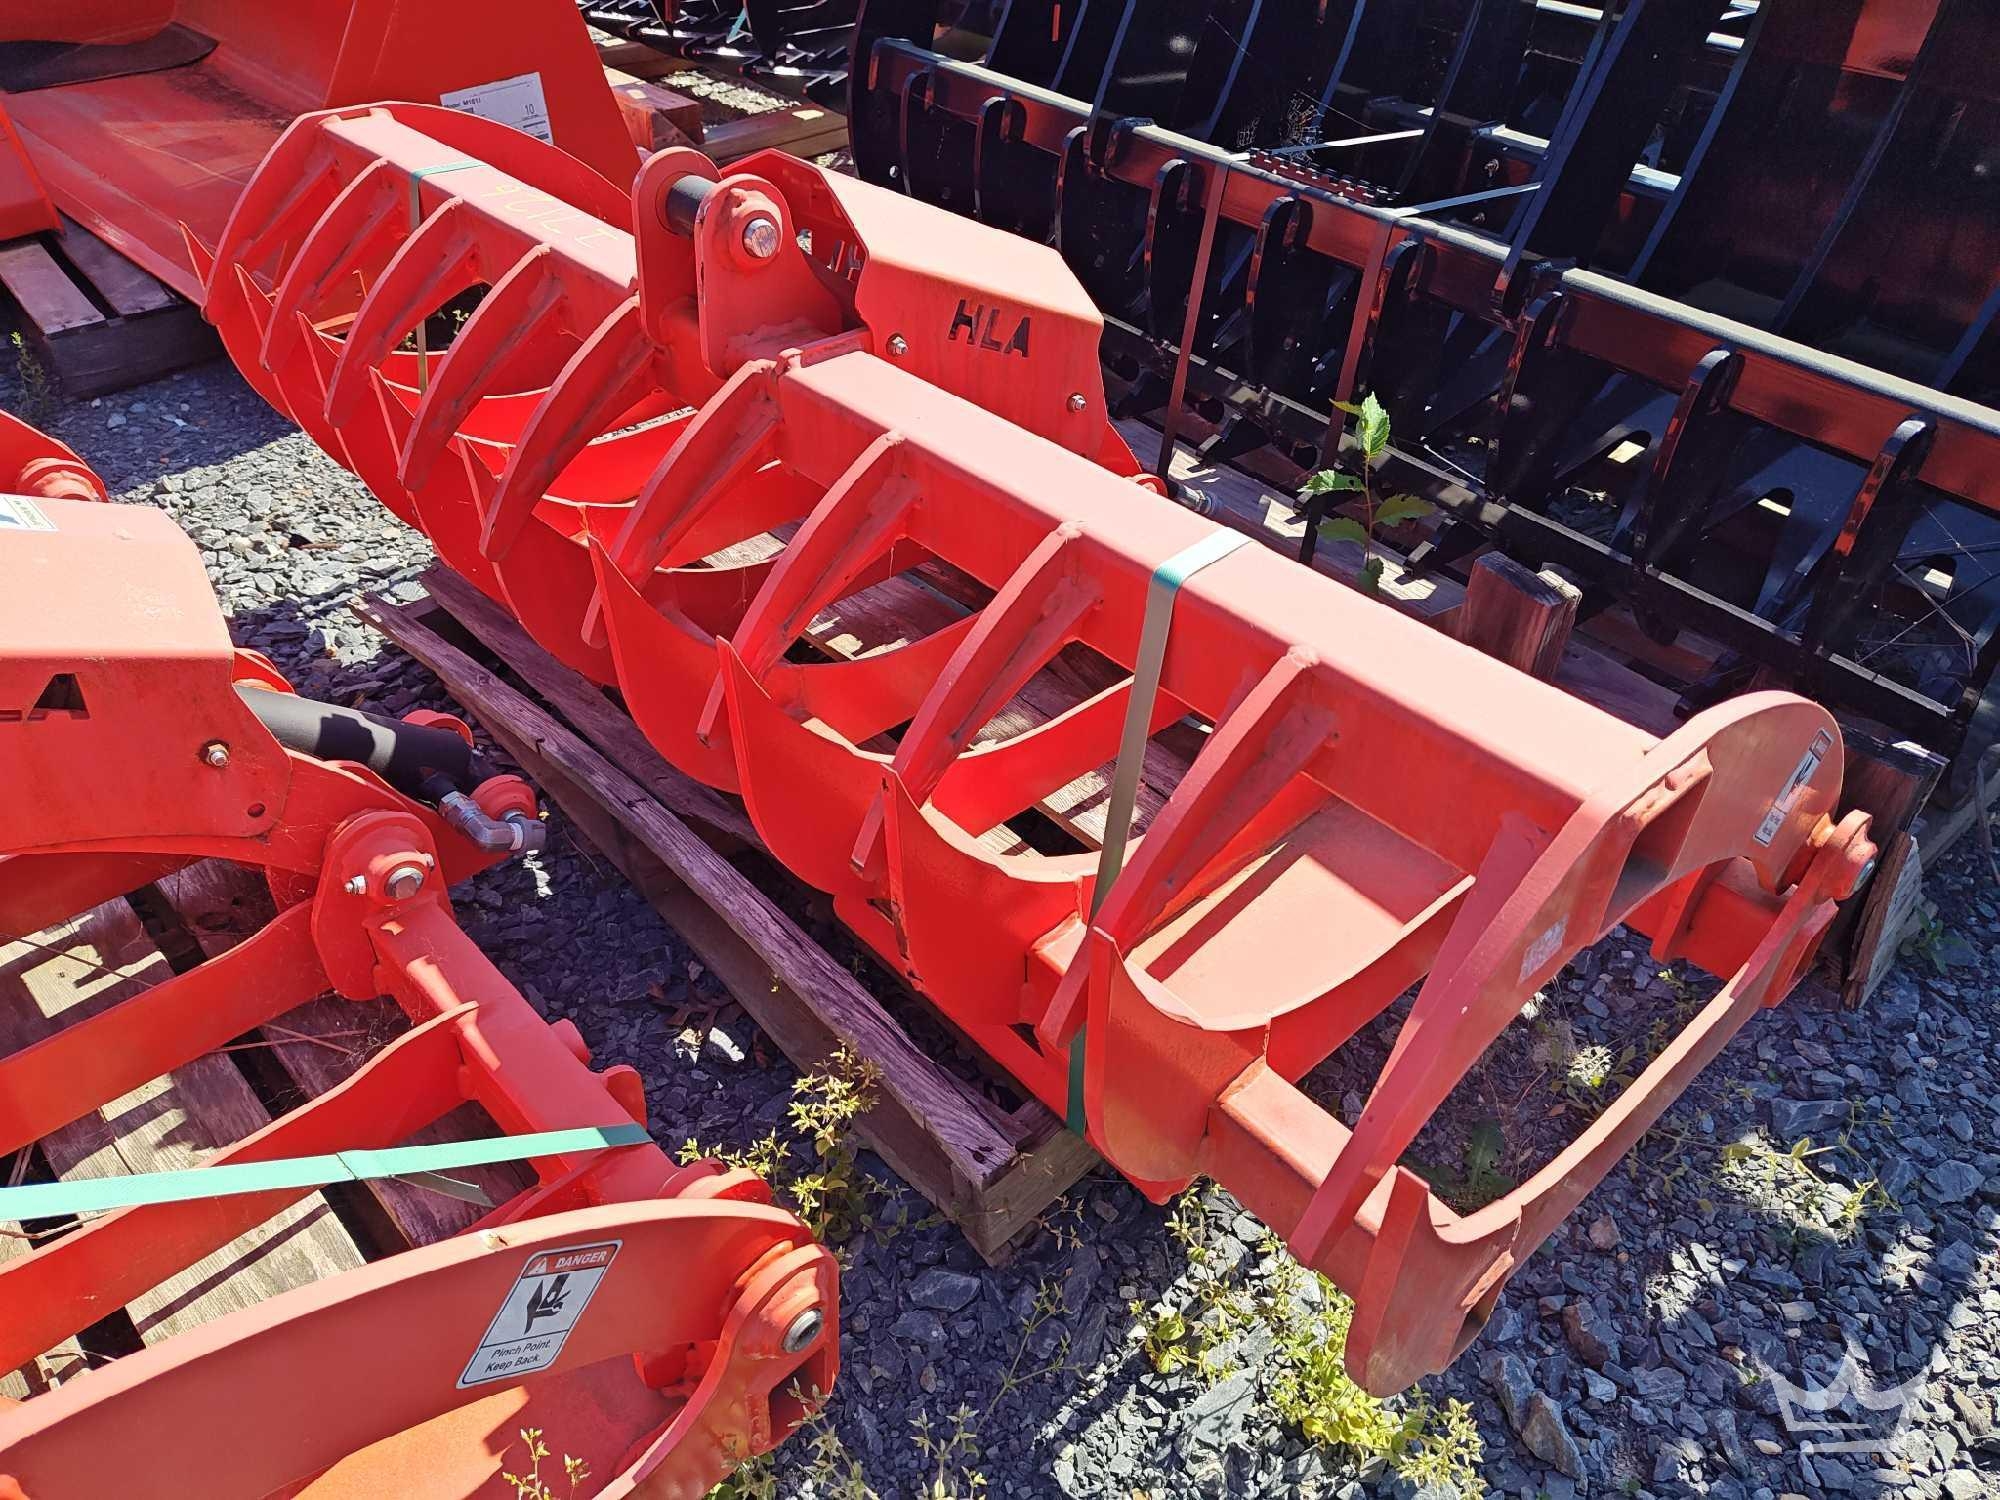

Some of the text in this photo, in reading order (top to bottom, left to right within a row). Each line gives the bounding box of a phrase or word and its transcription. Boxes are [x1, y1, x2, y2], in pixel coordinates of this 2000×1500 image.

[524, 103, 536, 116] 10
[948, 299, 1031, 358] HLA
[555, 1251, 607, 1268] DANGER
[490, 1346, 522, 1359] Pinch
[484, 1361, 513, 1374] Keep
